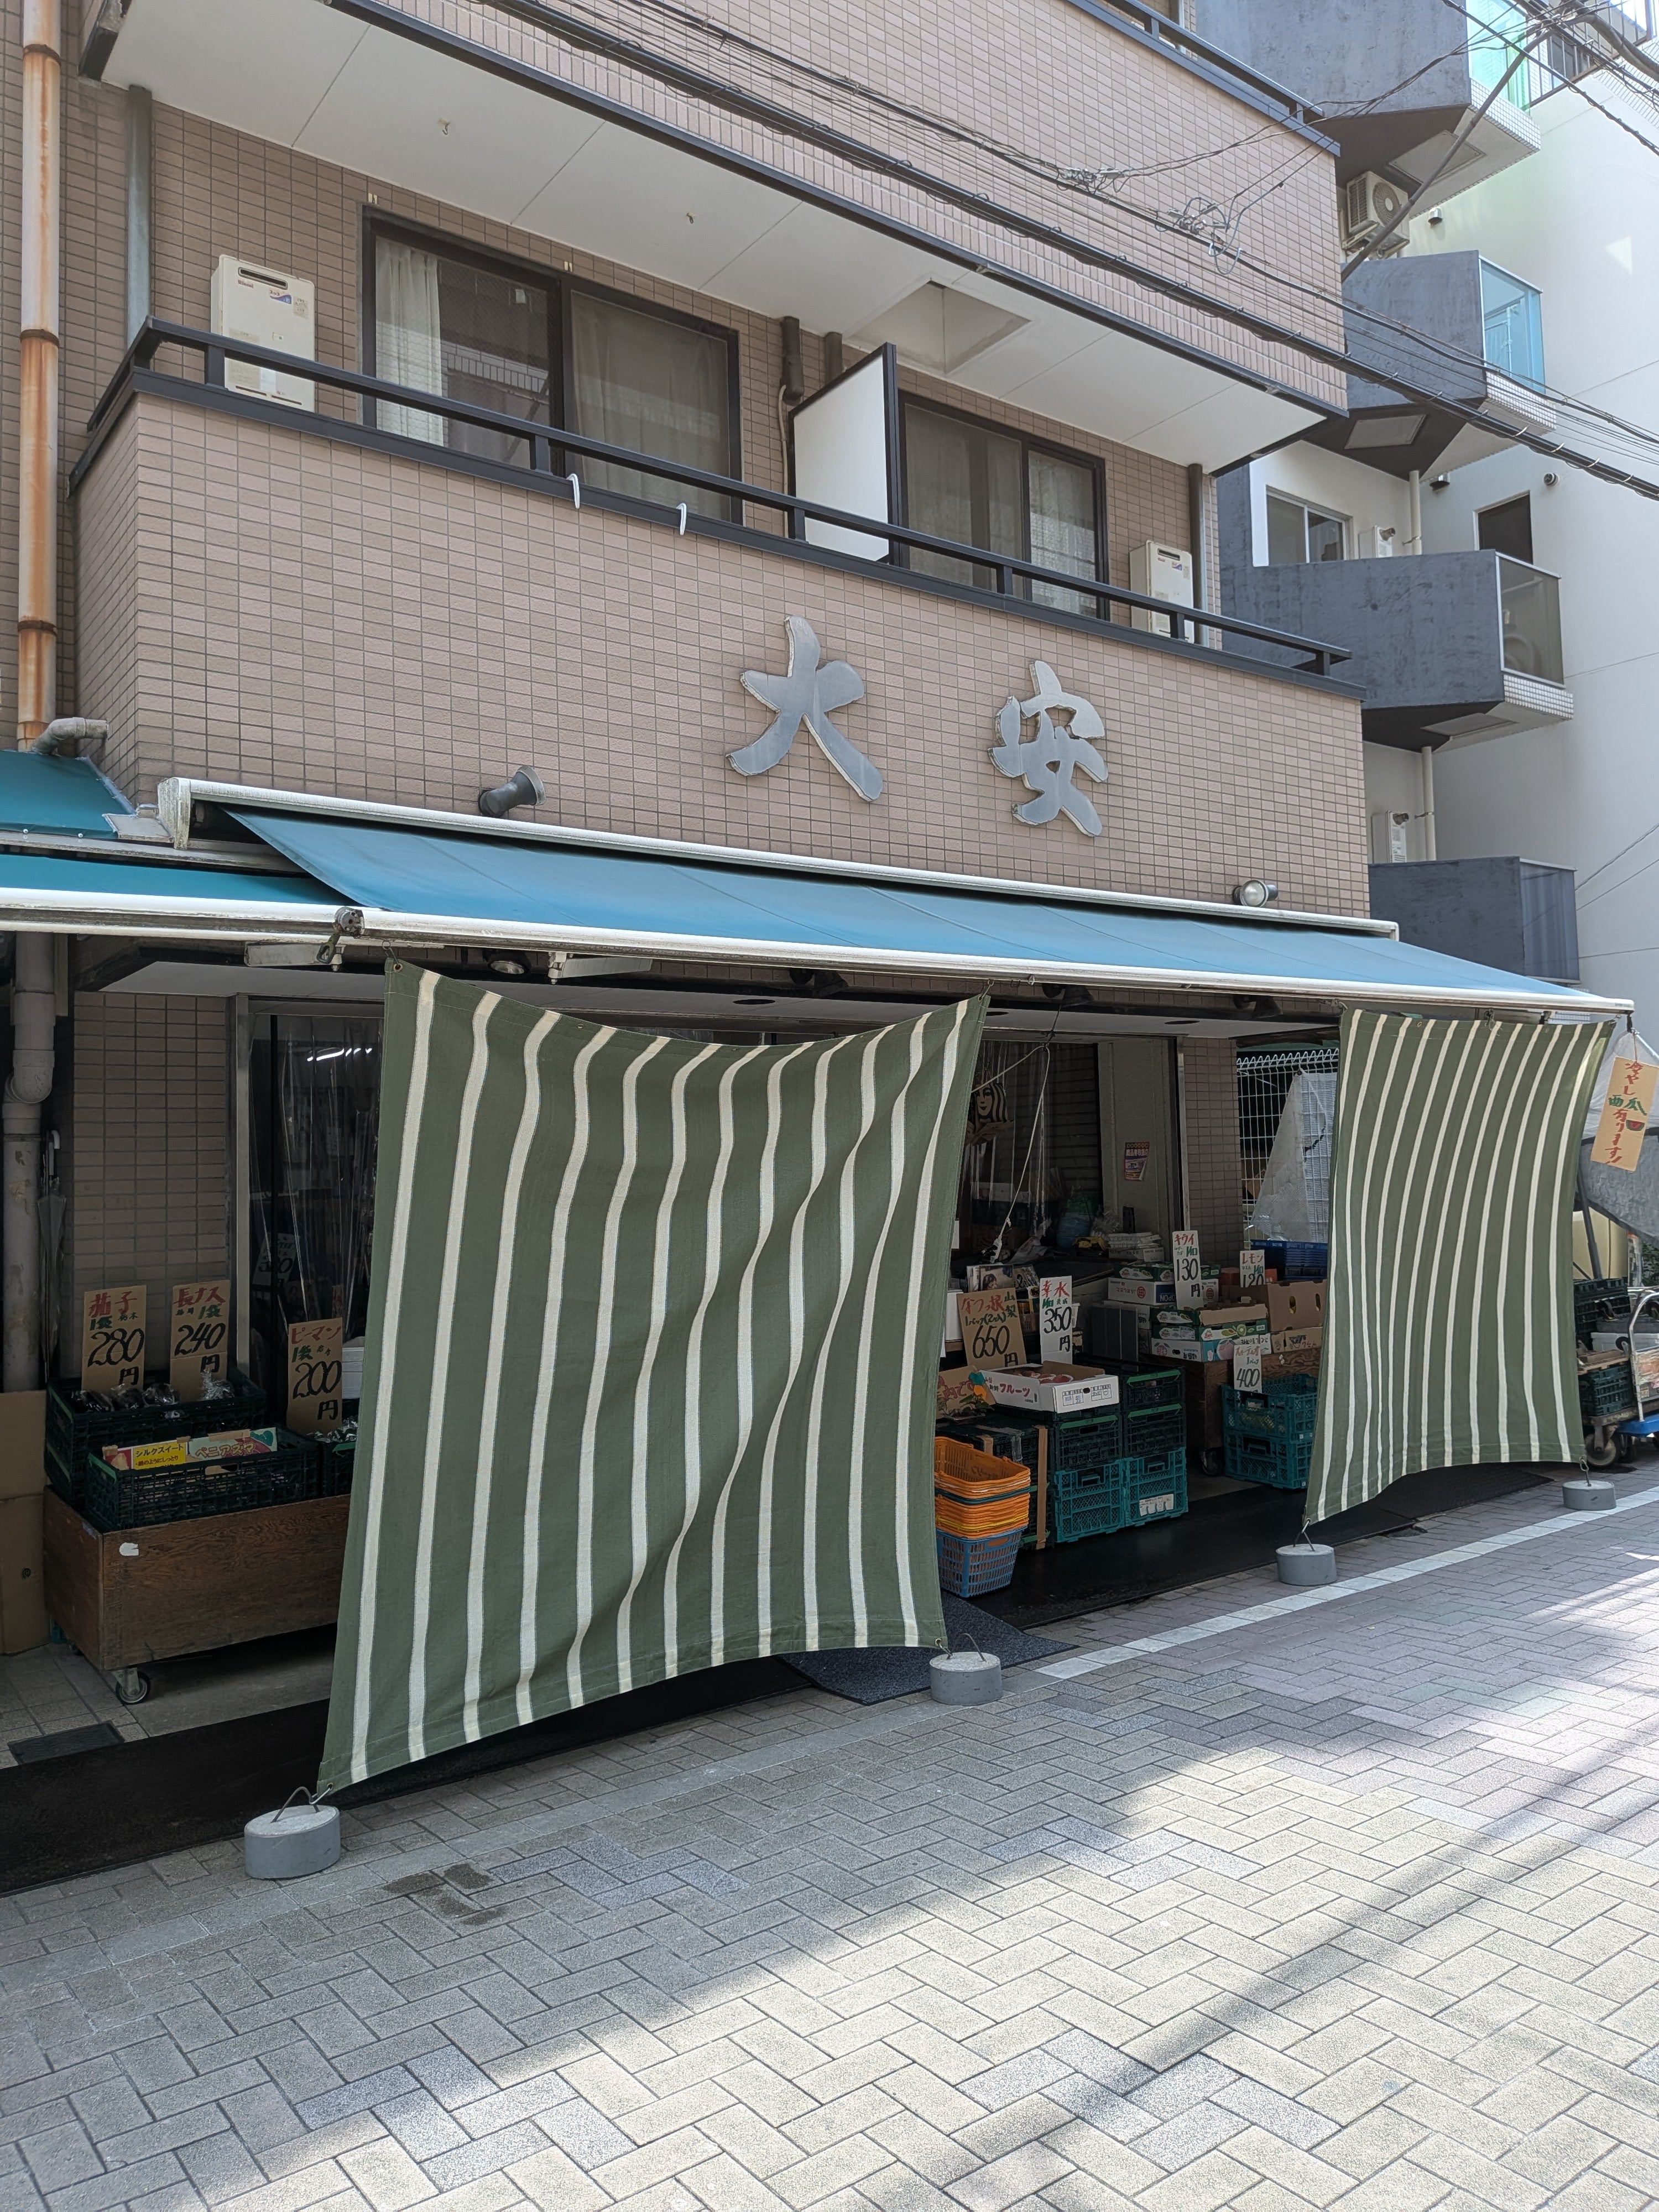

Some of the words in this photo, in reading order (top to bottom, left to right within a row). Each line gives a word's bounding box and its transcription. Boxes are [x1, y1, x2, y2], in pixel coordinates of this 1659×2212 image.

[726, 614, 1108, 838] 大安
[1623, 1061, 1643, 1095] 冷やし
[1609, 1095, 1647, 1115] 西瓜
[1174, 1234, 1194, 1245] キウイ
[1242, 1253, 1263, 1265] レモン
[1177, 1259, 1198, 1281] 130
[1041, 1280, 1071, 1298] 幸水
[1191, 1283, 1201, 1297] 円
[1243, 1274, 1264, 1288] 120
[88, 1291, 137, 1318] 茄子
[173, 1286, 226, 1308] 長ナス
[198, 1303, 223, 1319] 1袋
[1044, 1307, 1072, 1334] 350
[90, 1316, 113, 1331] 1袋
[175, 1322, 226, 1356] 240
[291, 1326, 341, 1344] ピーマン
[973, 1326, 1010, 1359] 650
[1060, 1335, 1071, 1352] 円
[87, 1328, 144, 1368] 280
[291, 1345, 314, 1363] 1袋
[200, 1354, 220, 1373] 円
[1004, 1352, 1019, 1368] 円
[119, 1366, 139, 1385] 円
[293, 1360, 342, 1399] 200
[1236, 1368, 1260, 1387] 400
[317, 1399, 338, 1420] 円
[136, 1444, 184, 1458] シルクスイート
[195, 1442, 255, 1458] ベニアズマ
